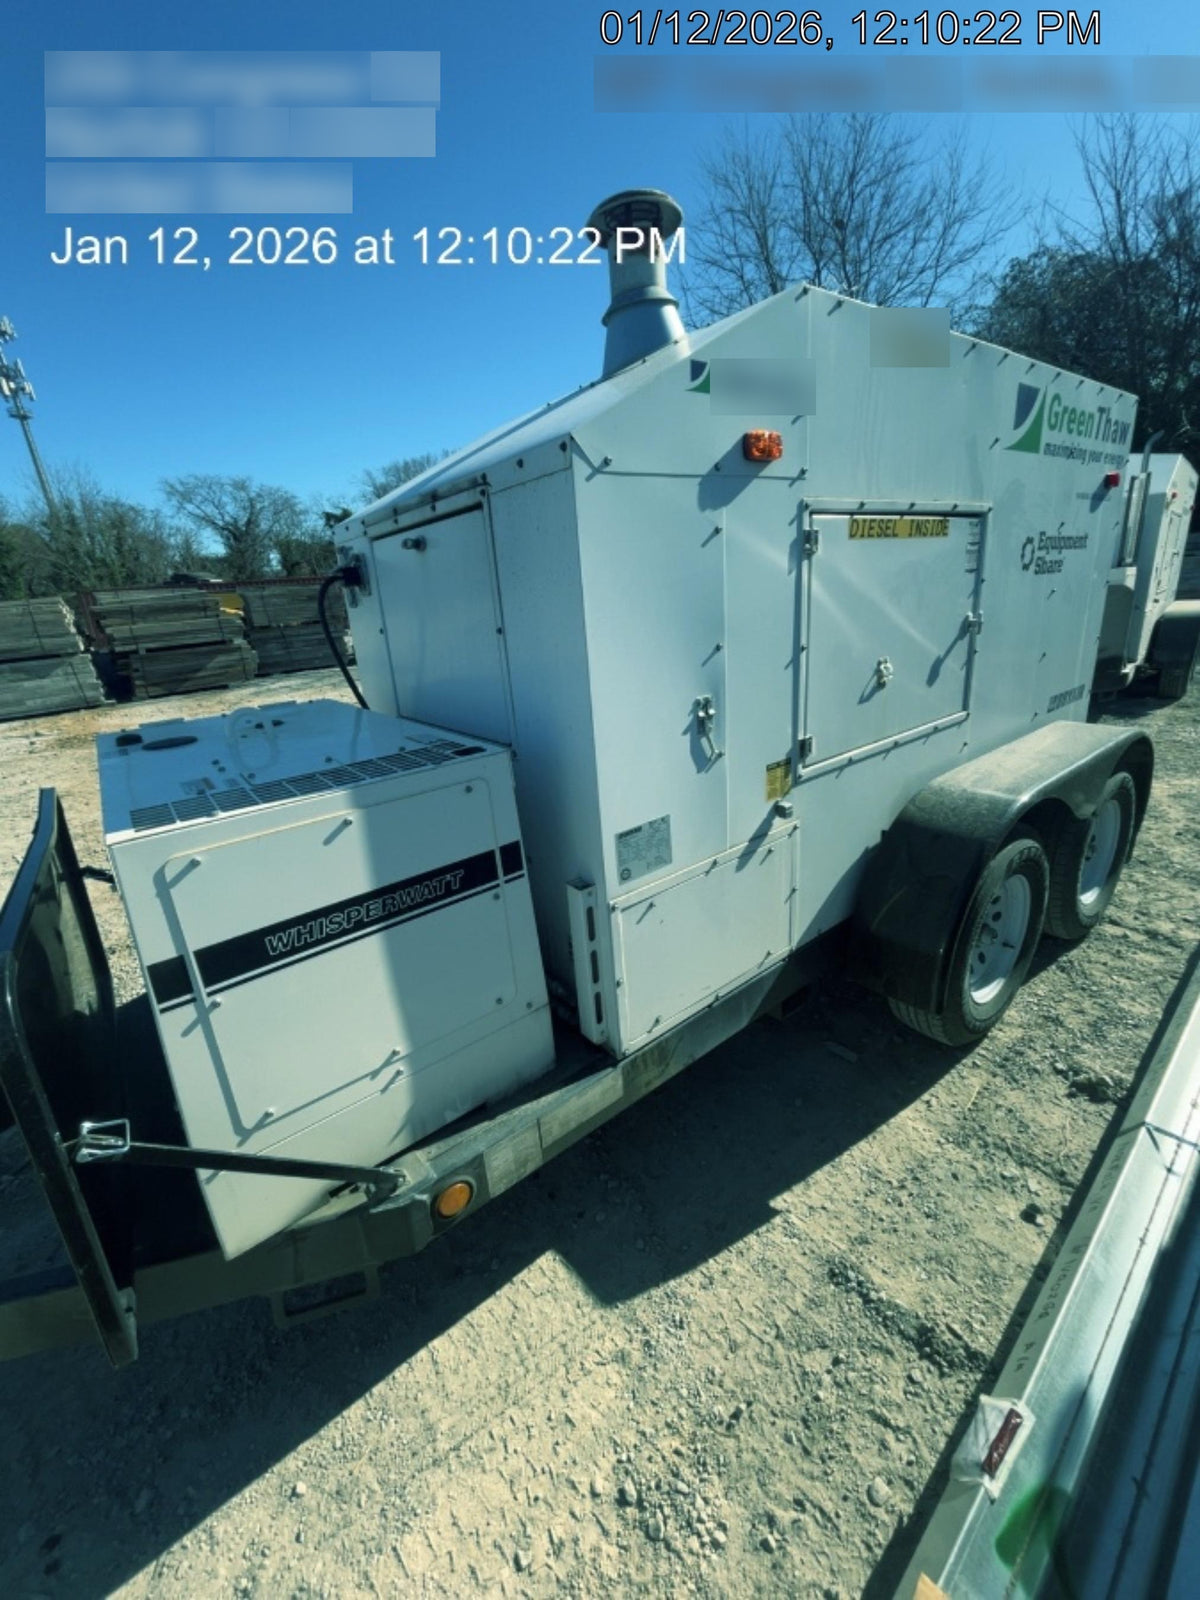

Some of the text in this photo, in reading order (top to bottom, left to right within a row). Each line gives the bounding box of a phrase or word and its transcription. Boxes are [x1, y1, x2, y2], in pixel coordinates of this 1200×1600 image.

[1047, 392, 1131, 446] GreenThaw
[1087, 449, 1103, 466] your
[849, 518, 899, 539] DIESEL
[908, 518, 950, 538] INSIDE
[1037, 531, 1089, 555] Equipment
[1034, 556, 1064, 576] Share
[264, 868, 465, 957] WHISPERWATT
